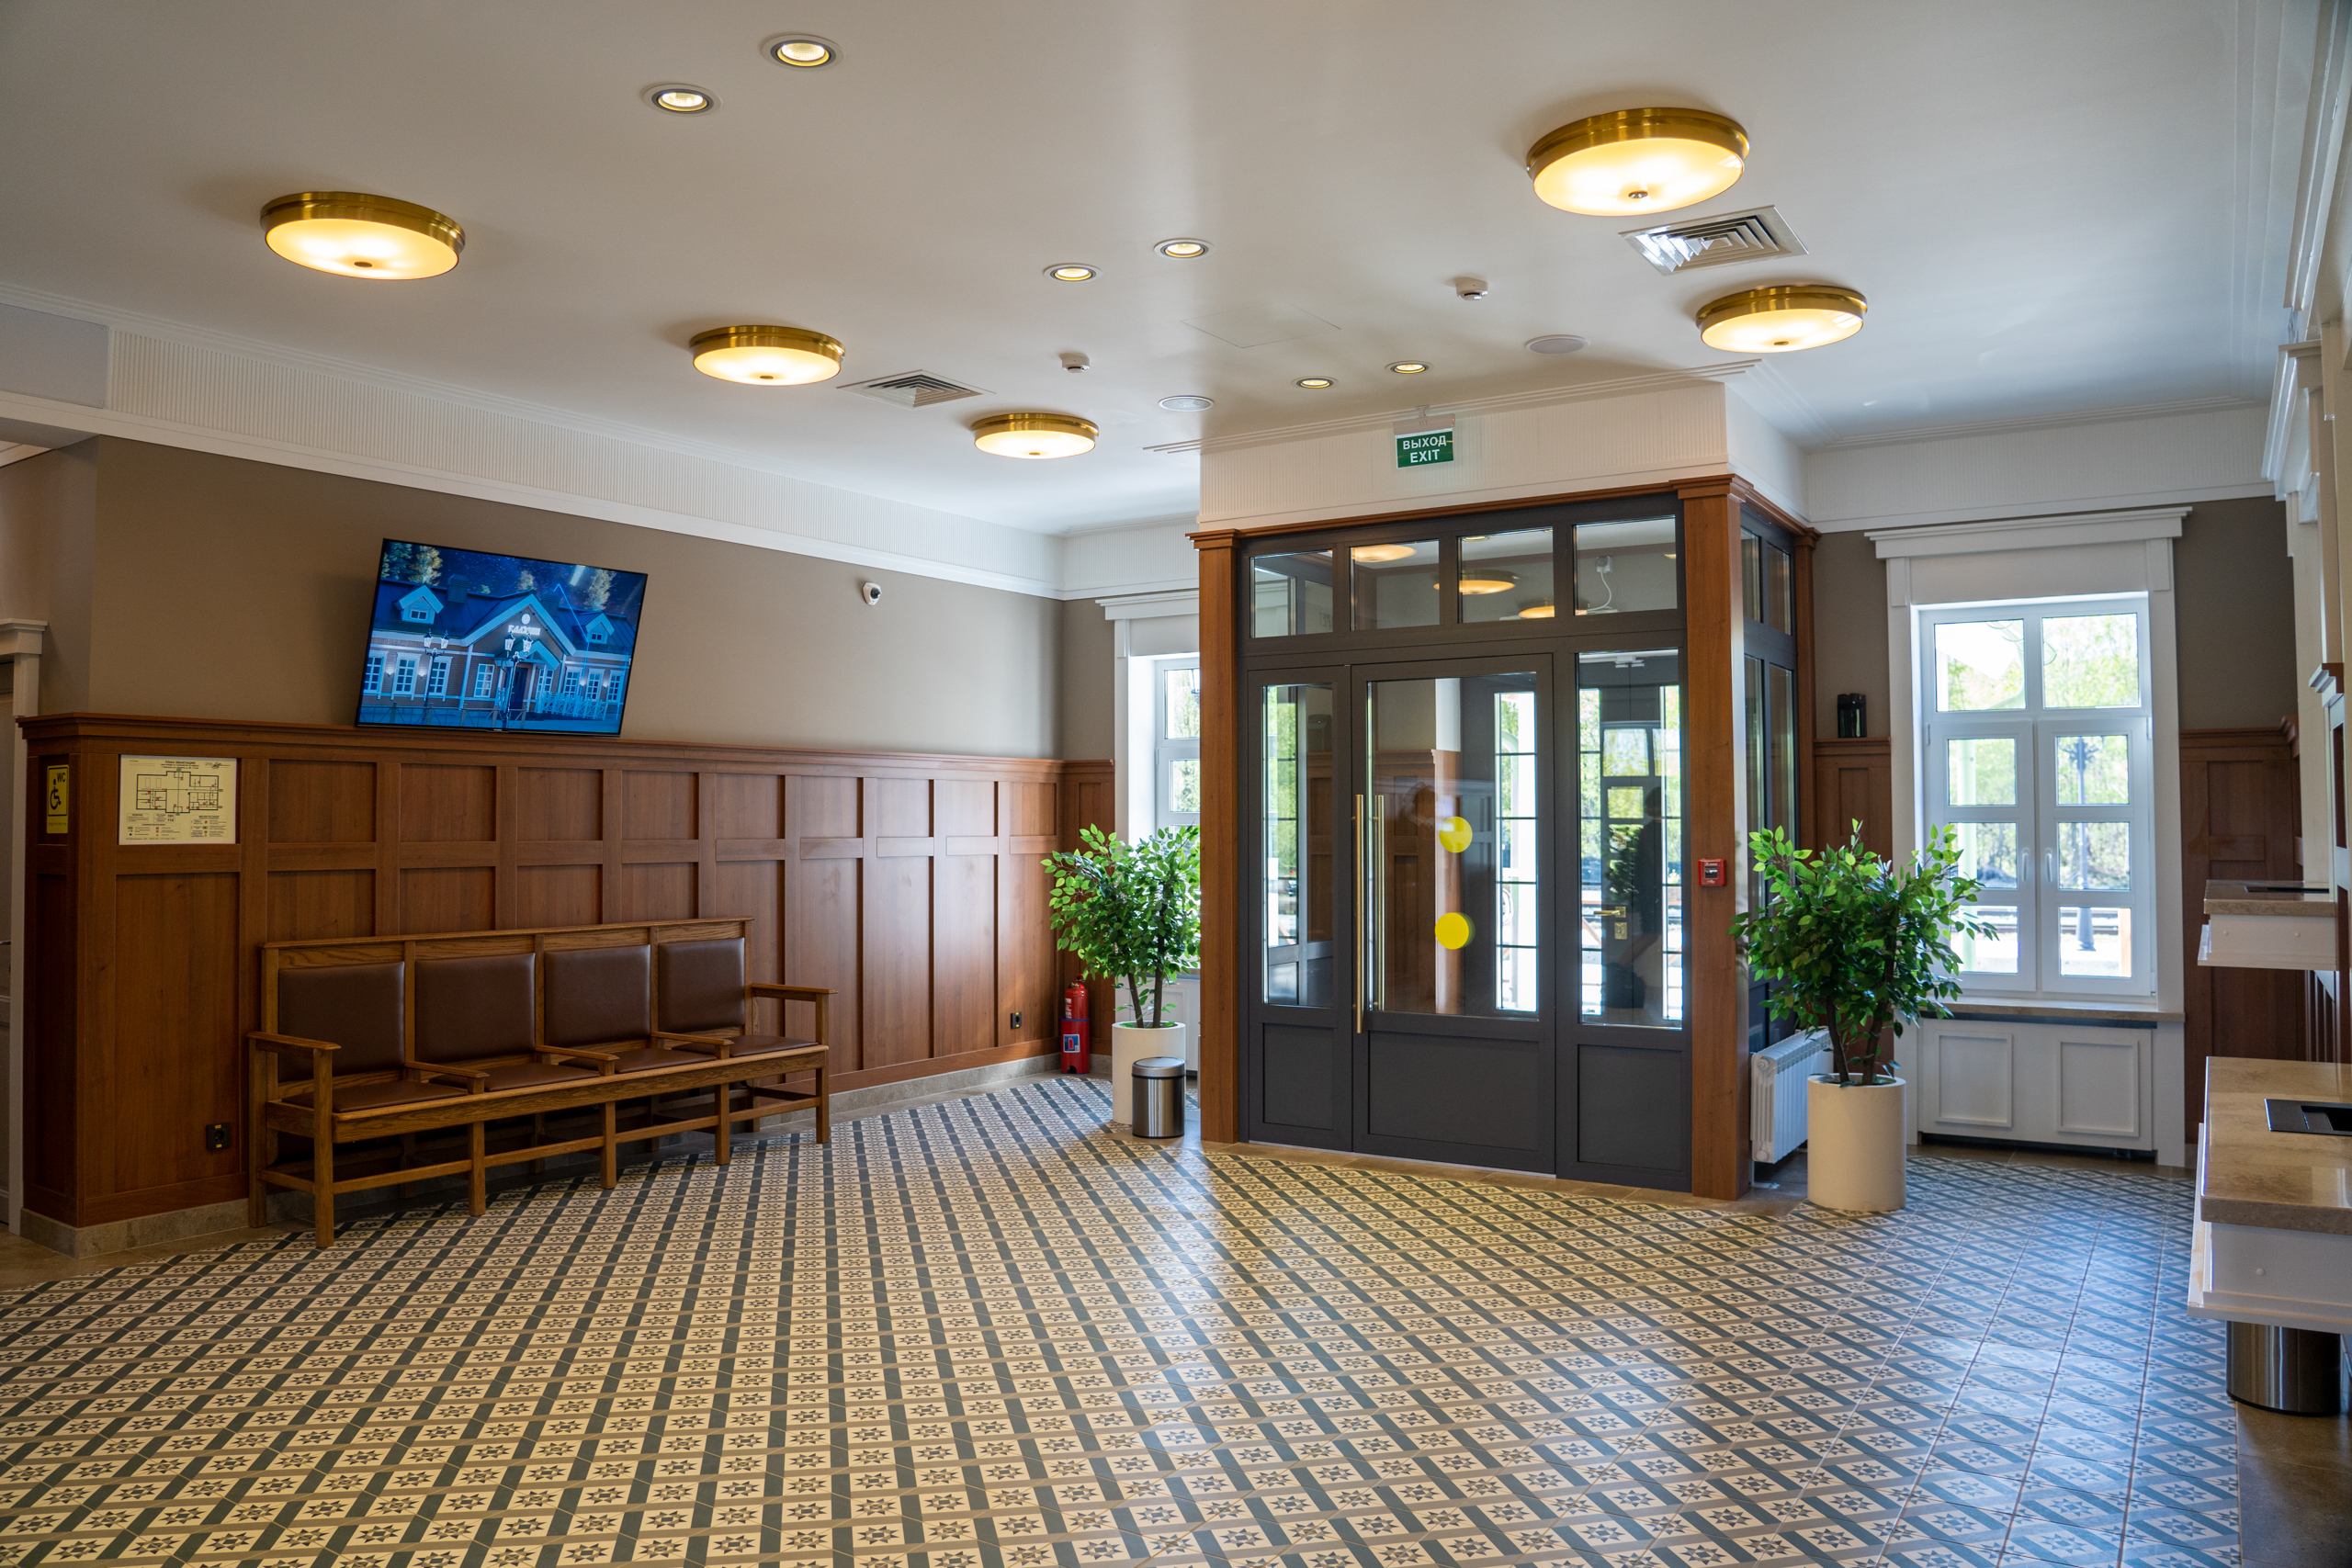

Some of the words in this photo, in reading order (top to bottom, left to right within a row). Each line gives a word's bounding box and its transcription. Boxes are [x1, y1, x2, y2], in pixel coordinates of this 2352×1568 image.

[1403, 435, 1446, 450] ВЫХОД
[1410, 449, 1440, 463] EXIT
[57, 773, 65, 783] WC
